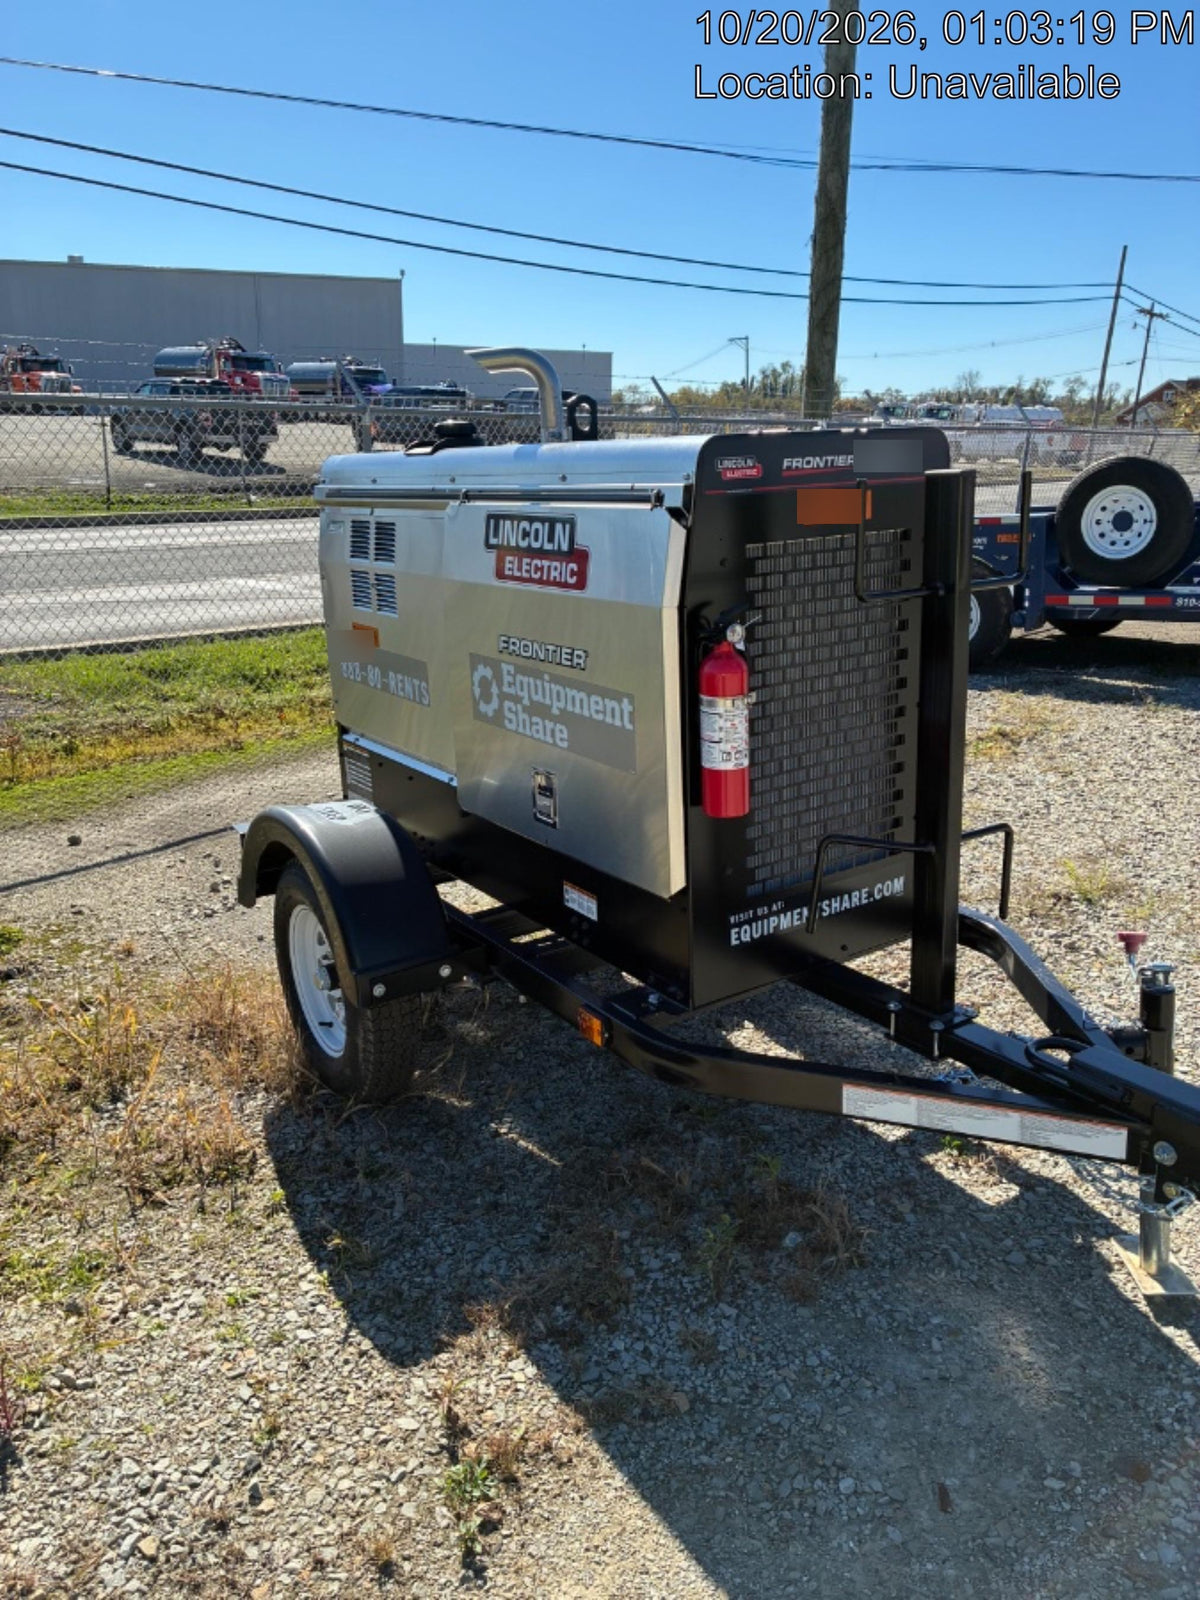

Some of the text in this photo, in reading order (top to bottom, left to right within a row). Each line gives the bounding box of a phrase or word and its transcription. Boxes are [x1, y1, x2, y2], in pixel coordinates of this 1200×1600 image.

[717, 458, 754, 469] LINCOLN
[726, 468, 758, 478] ELECTRIC
[488, 518, 570, 552] LINCOLN
[504, 555, 578, 584] ELECTRIC
[498, 634, 589, 671] FRONTIER
[501, 662, 634, 730] Equipment
[503, 700, 569, 748] Share
[729, 900, 785, 924] VISIT US AT:
[730, 875, 905, 947] EQUIPMENSHARE.COM
